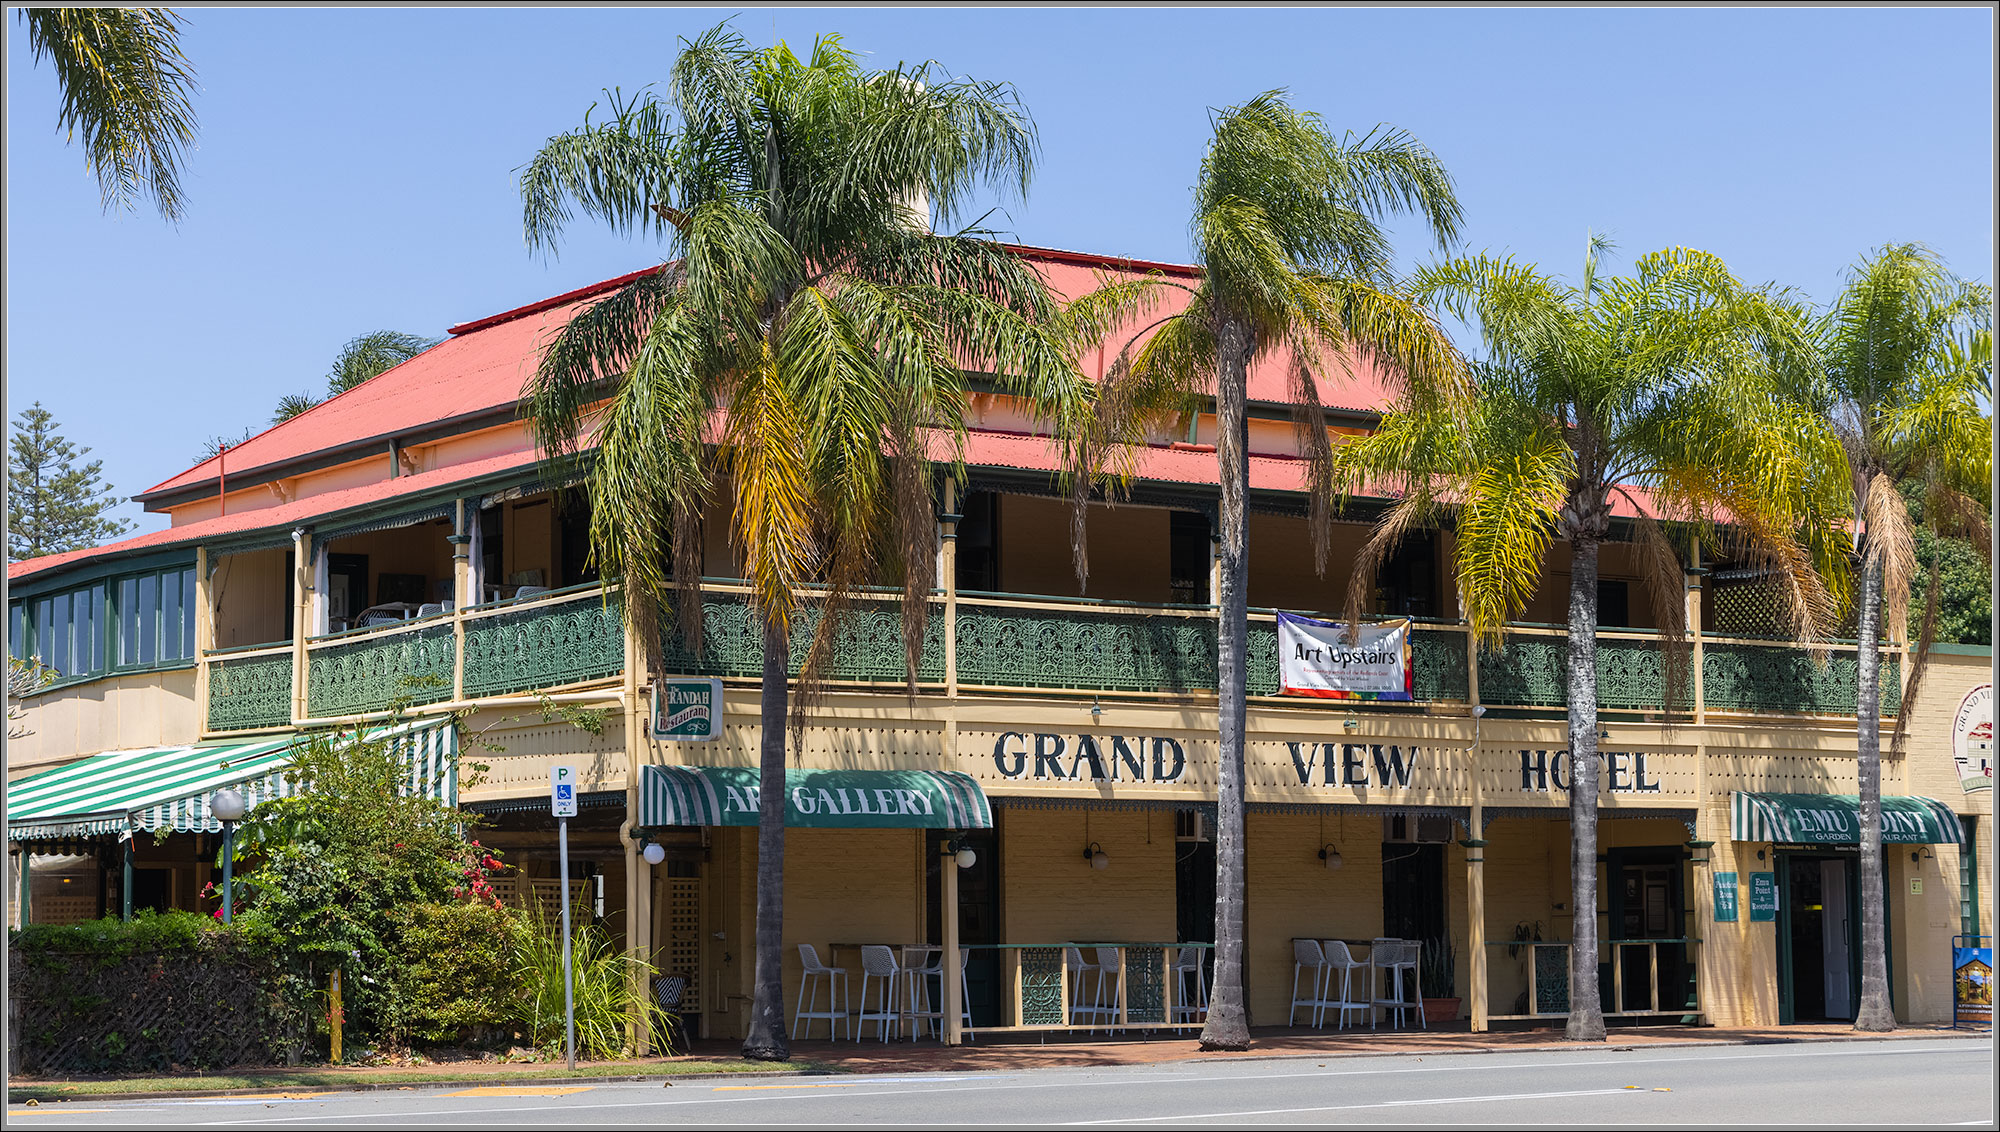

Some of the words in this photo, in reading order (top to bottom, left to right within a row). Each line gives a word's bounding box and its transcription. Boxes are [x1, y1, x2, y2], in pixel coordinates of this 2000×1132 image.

[1294, 642, 1323, 663] Art
[1329, 645, 1396, 669] Upstairs
[667, 691, 710, 705] RANDAH
[659, 706, 708, 730] Restaurant
[1958, 695, 1979, 732] GRAND
[993, 731, 1187, 784] GRAND
[1285, 741, 1419, 789] VIEW
[1519, 749, 1661, 793] HOEL
[558, 767, 568, 781] P
[724, 785, 762, 813] AR
[791, 786, 934, 815] GALLERY
[1794, 808, 1850, 832] EMU
[1815, 833, 1851, 841] GARDEN
[1754, 877, 1770, 886] Emu
[1754, 886, 1771, 895] Point
[1751, 902, 1775, 911] Reception
